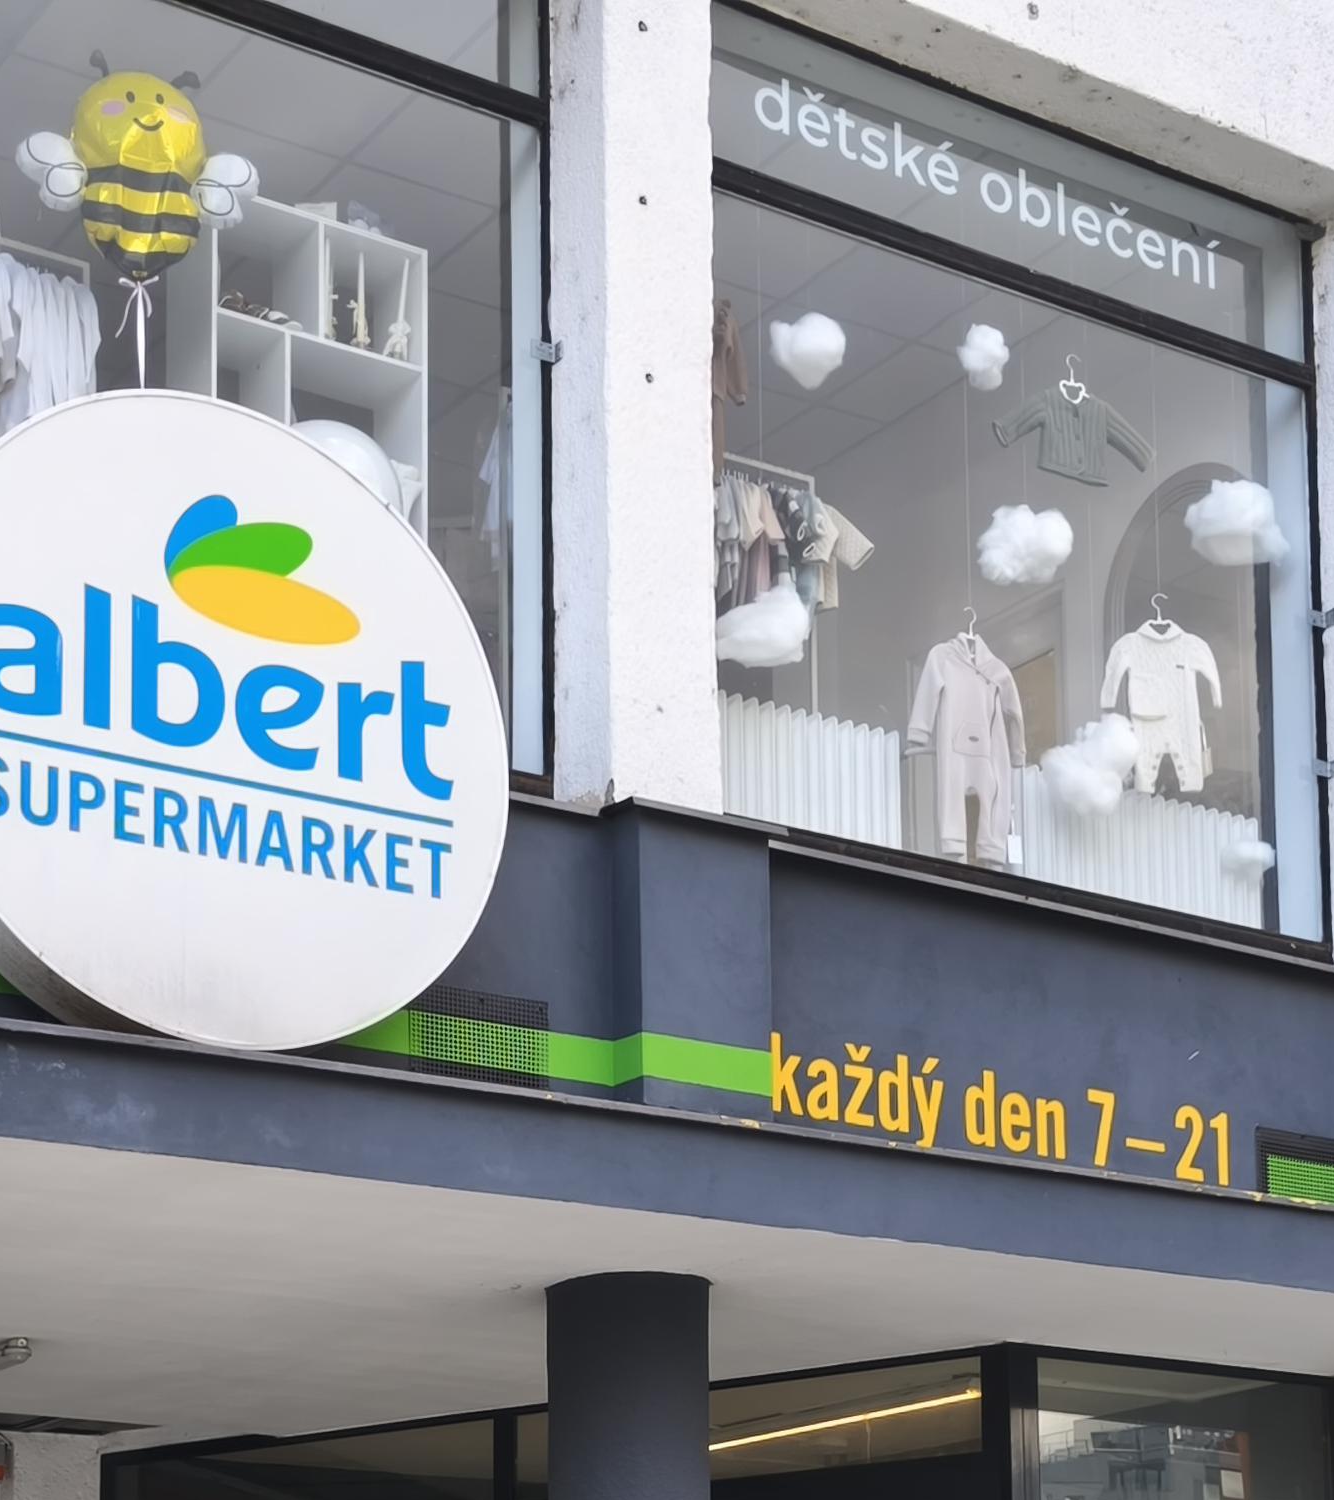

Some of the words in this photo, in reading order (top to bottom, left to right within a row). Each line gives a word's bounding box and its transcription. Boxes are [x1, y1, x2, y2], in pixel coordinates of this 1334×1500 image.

[754, 78, 960, 194] dětské
[980, 168, 1222, 289] oblečení
[769, 1031, 945, 1148] každý
[964, 1069, 1066, 1160] den
